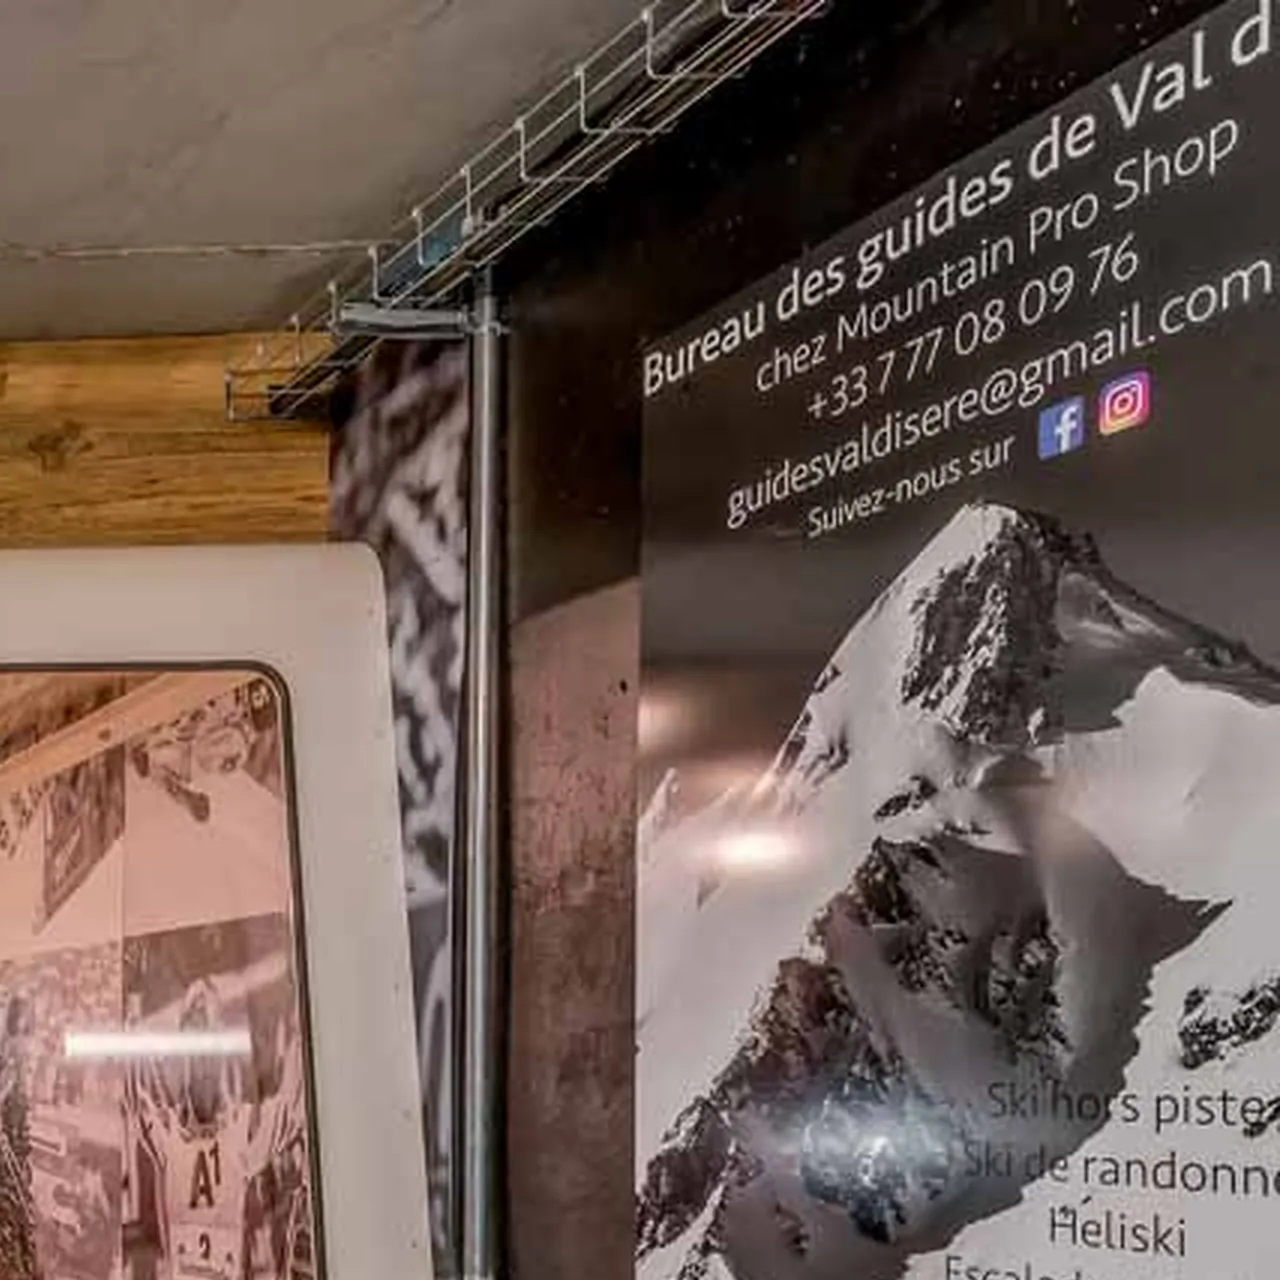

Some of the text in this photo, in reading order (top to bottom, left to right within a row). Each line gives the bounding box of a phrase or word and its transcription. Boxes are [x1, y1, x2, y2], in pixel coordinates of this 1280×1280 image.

[643, 302, 766, 397] Bureau
[776, 256, 845, 322] des
[856, 159, 1013, 290] guides
[1028, 115, 1096, 180] de
[1109, 30, 1214, 130] Val
[757, 119, 1238, 392] chez Mountain Pro Shop
[726, 259, 1273, 529] guidesvaldisere@gmail.com
[807, 232, 1139, 418] +33 7 77 08 09 76
[807, 456, 962, 538] Suivez-nous
[969, 436, 1016, 476] sur
[964, 1140, 1012, 1177] Ski
[1024, 1144, 1069, 1183] de
[988, 1081, 1038, 1118] Ski
[1052, 1079, 1139, 1124] hors
